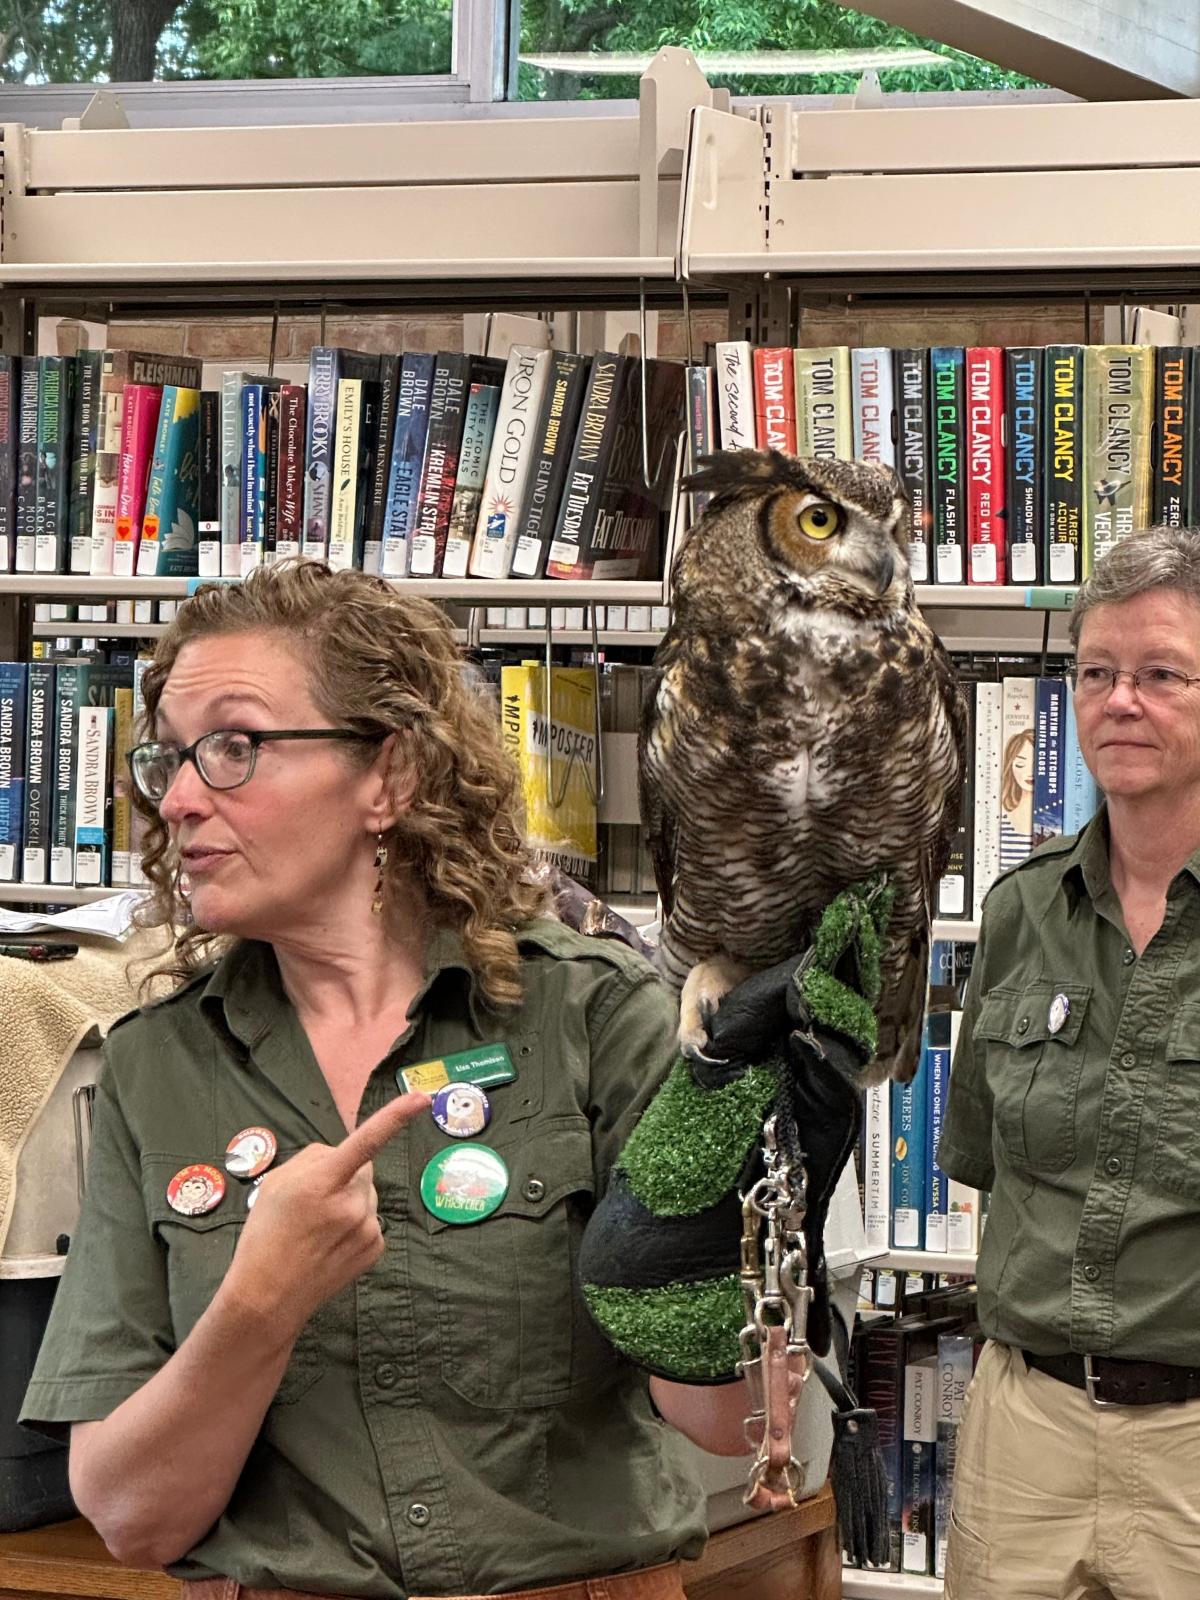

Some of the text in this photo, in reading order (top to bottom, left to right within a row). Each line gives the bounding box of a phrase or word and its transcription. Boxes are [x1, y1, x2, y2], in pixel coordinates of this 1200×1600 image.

[133, 361, 196, 386] FLEISHMAN
[722, 350, 742, 378] The
[763, 359, 784, 401] TOM
[812, 357, 835, 396] TOM
[860, 359, 879, 399] TOM
[21, 371, 38, 443] PATRICIA BRIGGS
[42, 370, 59, 443] PATRICIA BRIGGS
[247, 392, 255, 406] not
[311, 353, 333, 458] TERRY BROOKS
[378, 379, 391, 439] CANDLELIT
[399, 370, 413, 418] BROWN
[411, 379, 426, 410] DALE
[429, 368, 448, 420] BROWN
[445, 378, 463, 414] DALE
[549, 379, 567, 417] SANDRA
[1108, 356, 1132, 475] TOM CLANCY
[79, 364, 92, 496] THE LOST BOOK OF ELEANOR DARE
[159, 398, 172, 454] KATE BROMLEY
[223, 380, 237, 457] VISITORS
[246, 406, 255, 437] exactly
[340, 386, 354, 477] EMILY'S HOUSE
[461, 403, 478, 473] CITY GIRLS
[470, 402, 488, 478] THE ATOMIC
[499, 355, 537, 484] IRON GOLD
[542, 419, 562, 456] BROWN
[694, 432, 703, 447] the
[903, 359, 924, 482] TOM CLANCY
[936, 360, 957, 484] TOM CLANCY
[971, 359, 991, 484] TOM CLANCY
[1014, 360, 1035, 484] TOM CLANCY
[1054, 356, 1074, 482] TOM CLANCY
[1162, 359, 1183, 486] TOM CLANCY
[122, 453, 134, 474] Here
[247, 438, 255, 459] what
[282, 397, 299, 525] The Chocolate Maker's Wife
[561, 362, 616, 543] SANDRA BROWN FAT TUESDAY
[151, 476, 164, 495] Talk
[247, 464, 255, 481] had
[247, 481, 255, 490] in
[373, 444, 387, 507] MENAGERIE
[393, 467, 413, 506] EAGLE
[424, 449, 444, 501] KREMLIN
[532, 460, 552, 503] BLIND
[247, 490, 255, 513] mind
[913, 488, 923, 526] FIRING
[945, 488, 955, 527] FLASH
[980, 492, 991, 545] RED WIN
[1024, 486, 1033, 524] SHADOW
[1058, 501, 1067, 544] ACQUIR
[591, 508, 614, 550] FAT
[0, 698, 13, 744] SANDRA
[31, 689, 45, 736] SANDRA
[59, 699, 73, 745] SANDRA
[29, 739, 43, 784] BROWN
[1038, 711, 1047, 776] JENNIFER CLOSE
[1048, 694, 1058, 794] MARRYING KETCHUPS
[0, 746, 11, 789] BROWN
[57, 748, 71, 791] BROWN
[82, 729, 100, 825] SANDRA BROWN
[1074, 756, 1082, 791] CLOSE
[28, 789, 41, 847] OVERKIL
[58, 794, 67, 815] THICK
[58, 815, 66, 825] AS
[901, 1087, 912, 1185] TREES JON
[932, 1054, 941, 1208] WHEN NO ONE IS ALYSSA
[871, 1133, 880, 1209] SUMMERTIM
[911, 1371, 923, 1436] PAT CONROY
[941, 1363, 954, 1422] CONROY
[953, 1380, 966, 1401] PAT
[912, 1454, 921, 1471] THE
[911, 1473, 921, 1502] LORDS
